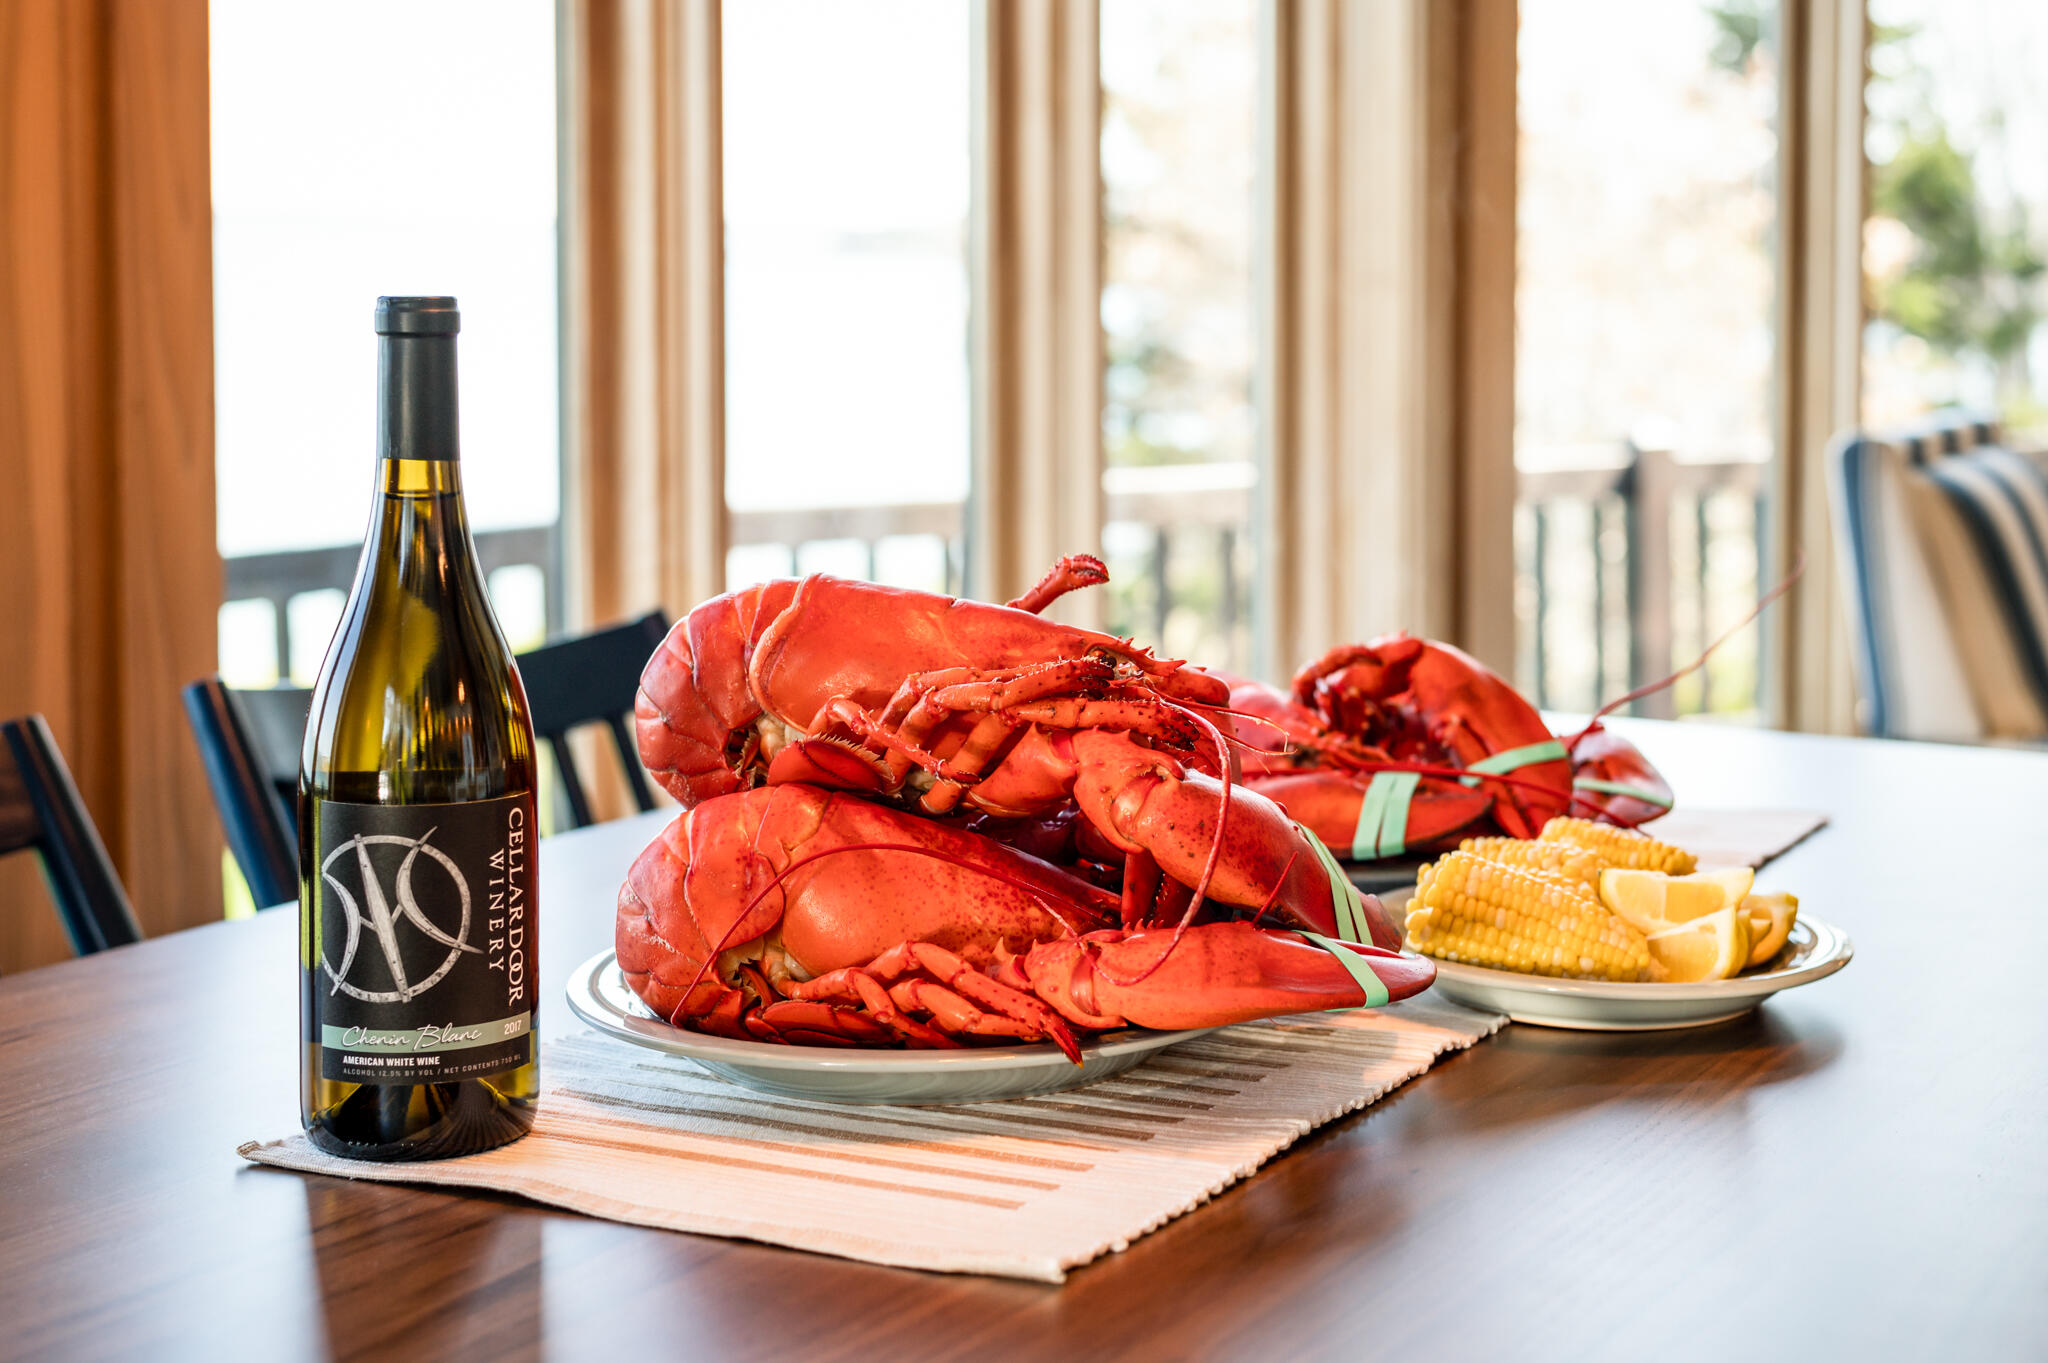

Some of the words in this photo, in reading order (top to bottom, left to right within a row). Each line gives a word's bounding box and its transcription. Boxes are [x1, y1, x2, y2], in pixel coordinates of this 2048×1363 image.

[488, 848, 505, 971] WINERY
[508, 807, 524, 1007] CELLARDOOR
[342, 1025, 410, 1047] Chenin
[412, 1022, 482, 1051] Blanc
[504, 1019, 522, 1035] 2017
[342, 1055, 384, 1066] AMERICAN
[386, 1057, 415, 1067] WHITE
[416, 1056, 440, 1066] WINE
[343, 1067, 376, 1077] ALCOHOL
[418, 1068, 434, 1076] VOL
[444, 1066, 459, 1074] NET
[462, 1059, 499, 1072] CONTENTS
